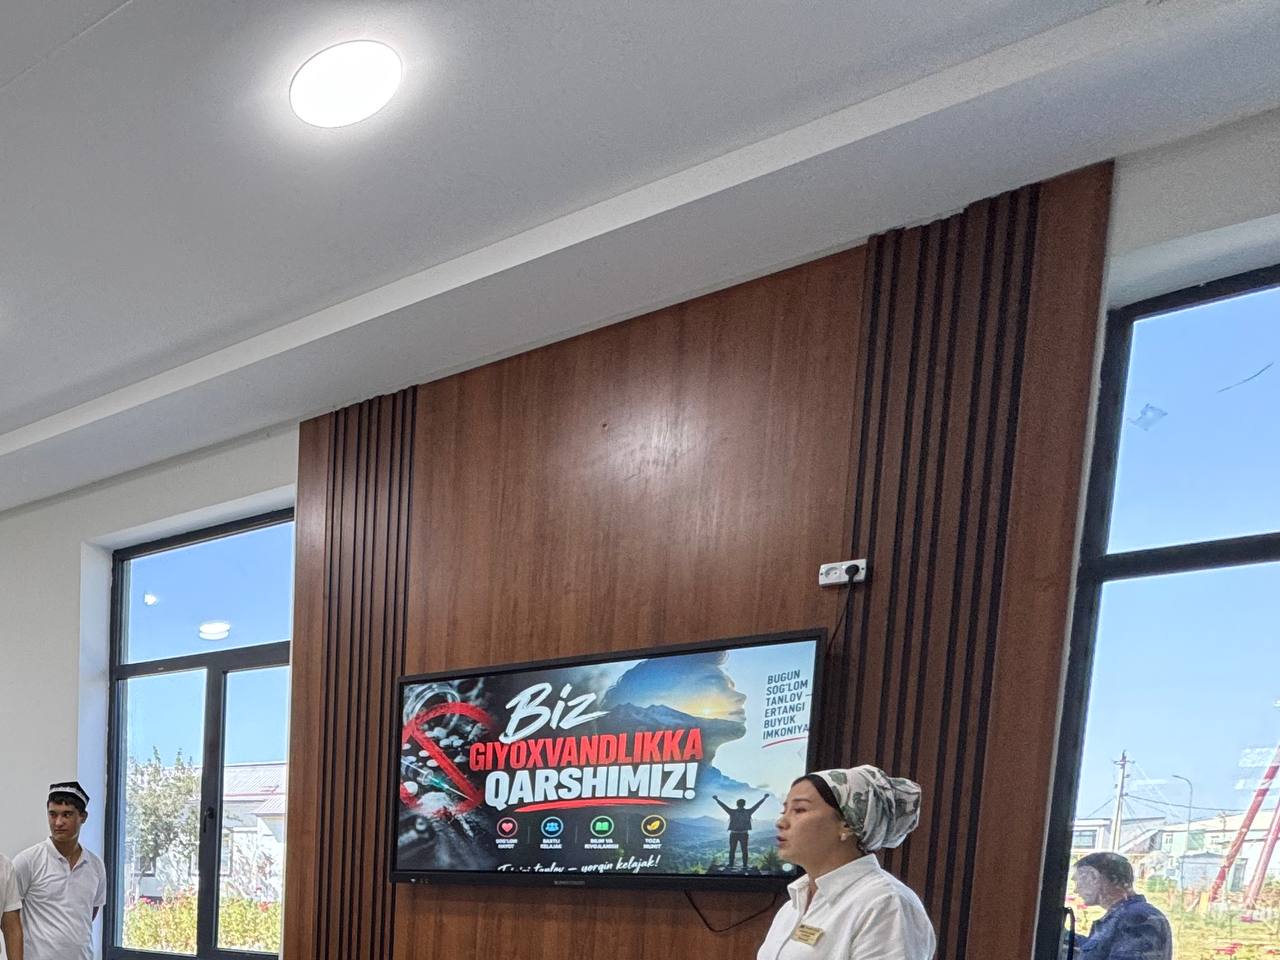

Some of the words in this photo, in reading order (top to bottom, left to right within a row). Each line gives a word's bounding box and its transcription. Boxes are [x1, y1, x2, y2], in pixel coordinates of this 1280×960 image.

[767, 669, 801, 685] BUGUN
[766, 691, 803, 707] TANLOV
[499, 682, 610, 744] Biz
[764, 702, 805, 718] ERTANGI
[763, 714, 796, 729] BUYUK
[469, 727, 704, 771] GIYOXVANDLIKKA
[484, 762, 699, 812] QARSHIMIZ!
[615, 854, 662, 873] kelajak!
